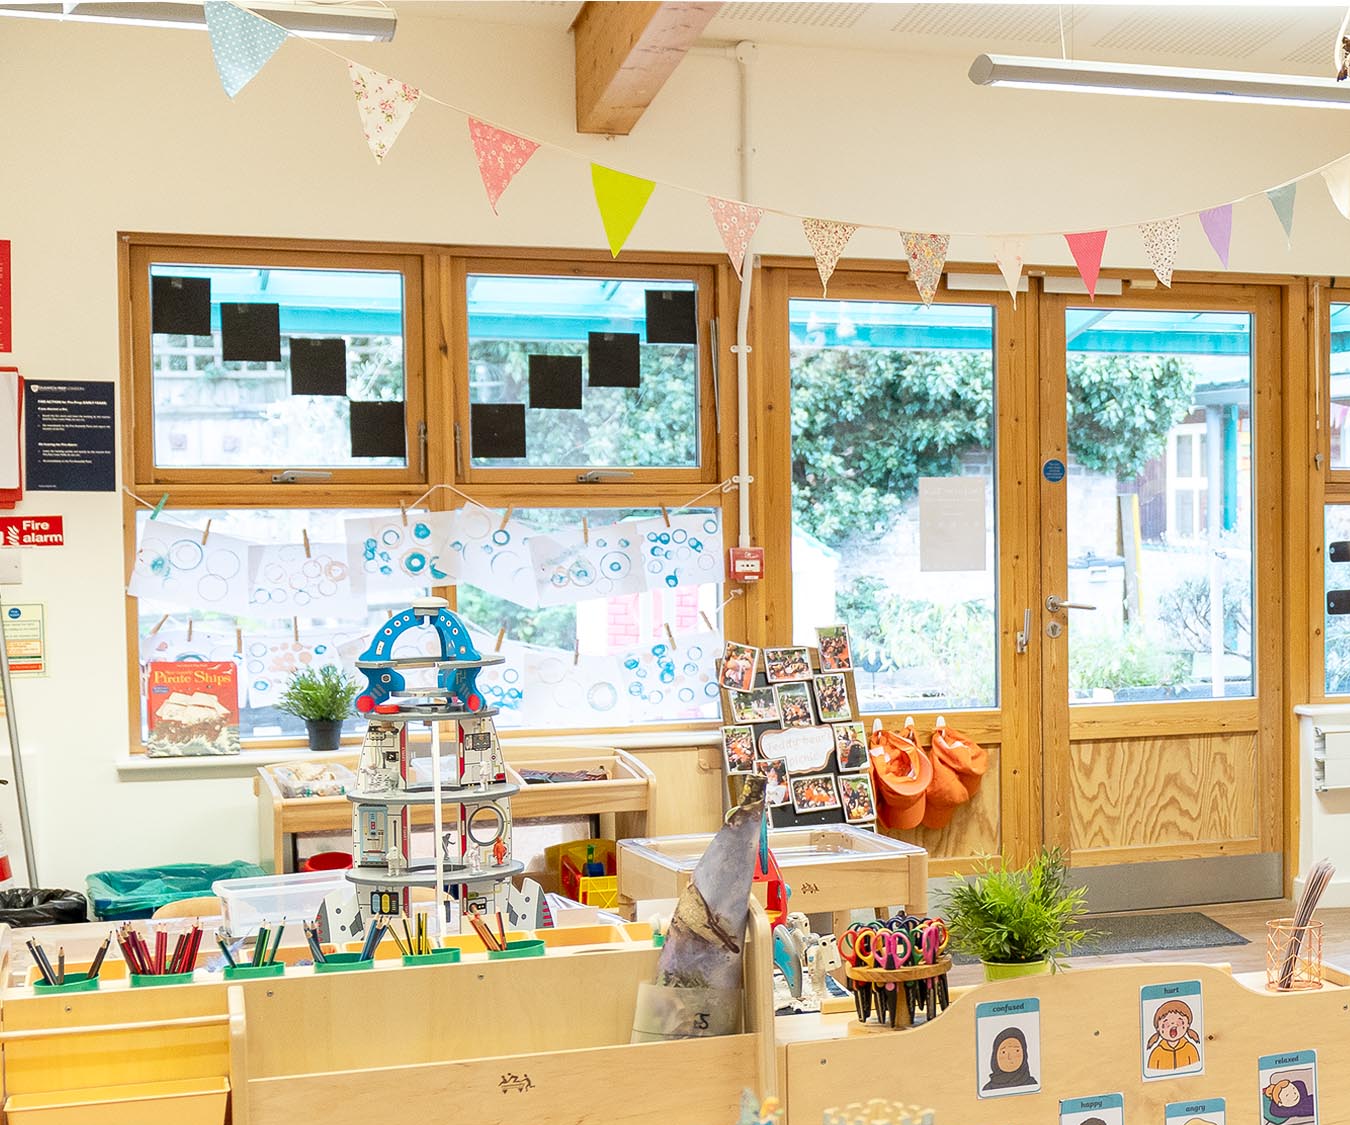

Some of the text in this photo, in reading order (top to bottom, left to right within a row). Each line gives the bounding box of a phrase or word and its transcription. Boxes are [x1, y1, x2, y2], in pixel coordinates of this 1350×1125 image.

[22, 520, 50, 531] Fire
[22, 532, 63, 543] alarm
[154, 670, 232, 686] Pirate Ships
[1163, 986, 1180, 995] hurt
[992, 1002, 1025, 1013] confused
[1274, 1055, 1299, 1065] relaxed
[1080, 1100, 1103, 1109] happy
[1185, 1104, 1206, 1113] angry
